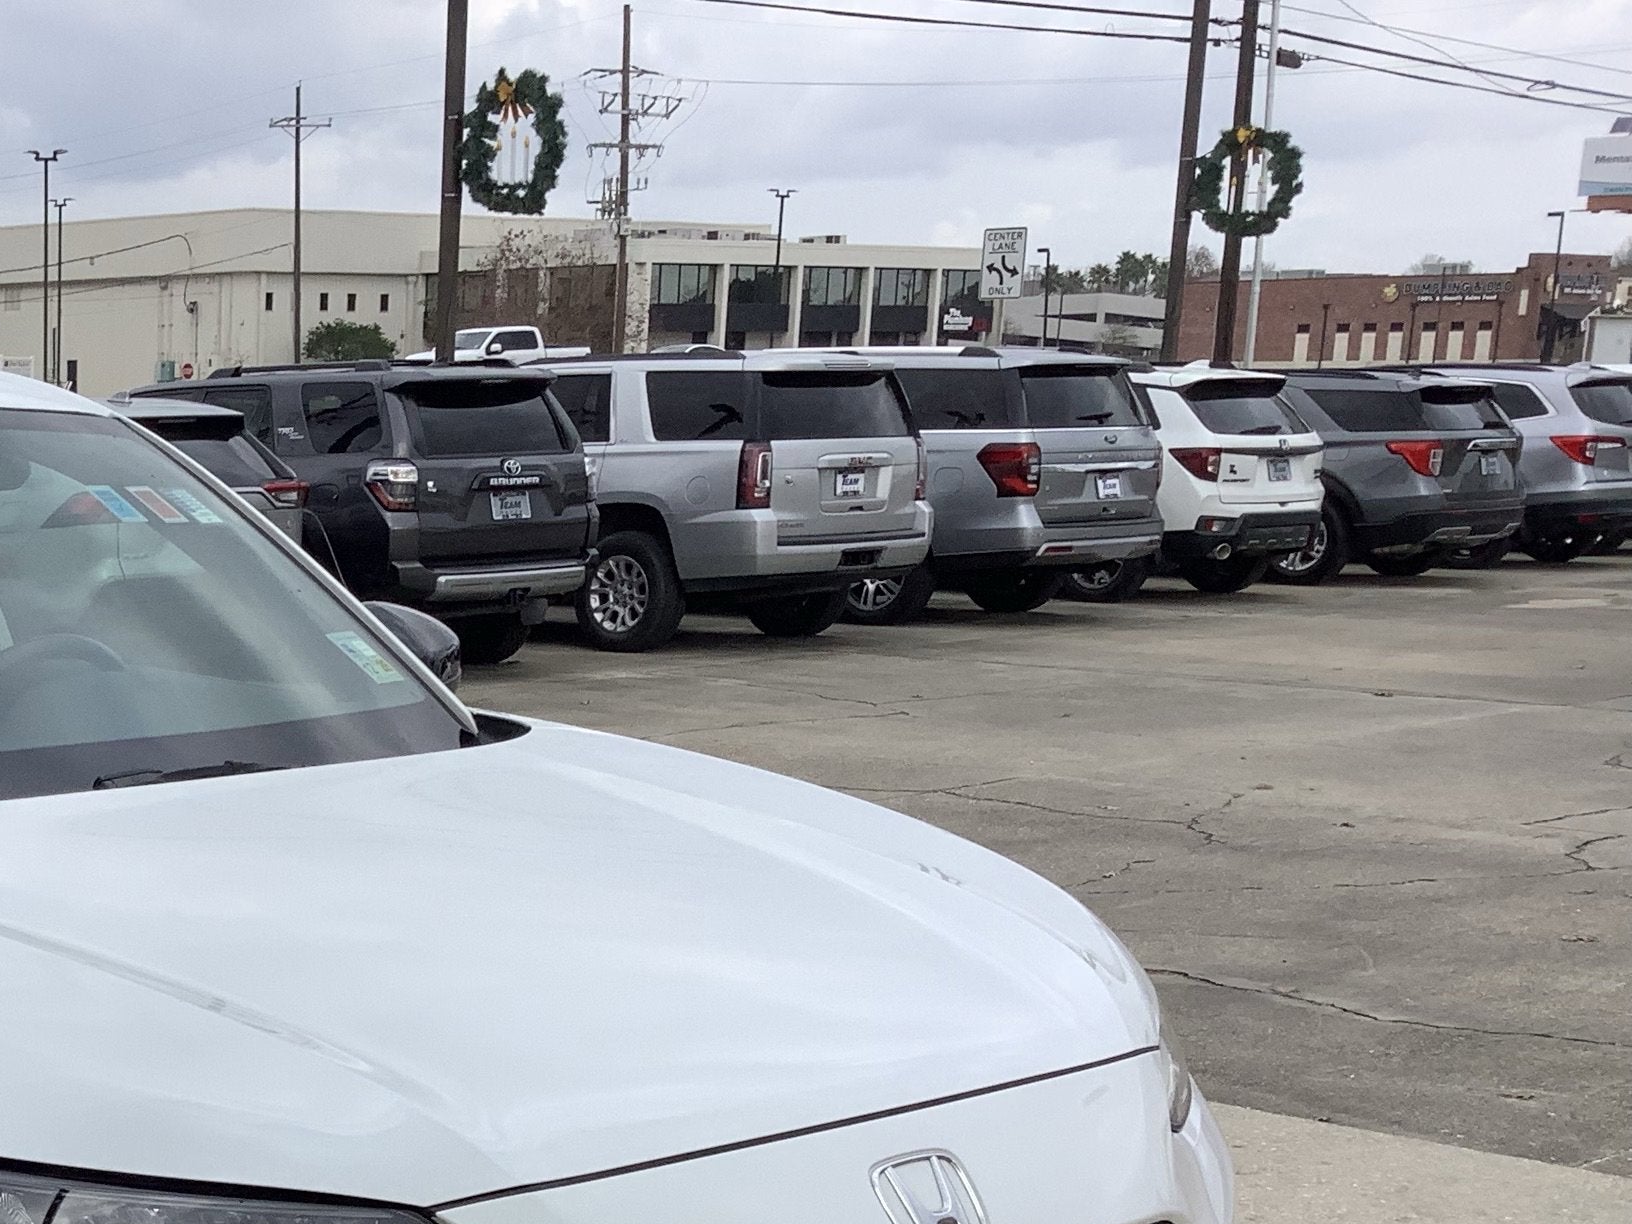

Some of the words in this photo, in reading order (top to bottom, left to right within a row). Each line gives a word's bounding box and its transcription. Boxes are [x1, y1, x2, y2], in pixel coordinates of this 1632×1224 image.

[987, 231, 1024, 242] CENTER
[992, 241, 1017, 251] LANE
[988, 286, 1014, 296] ONLY
